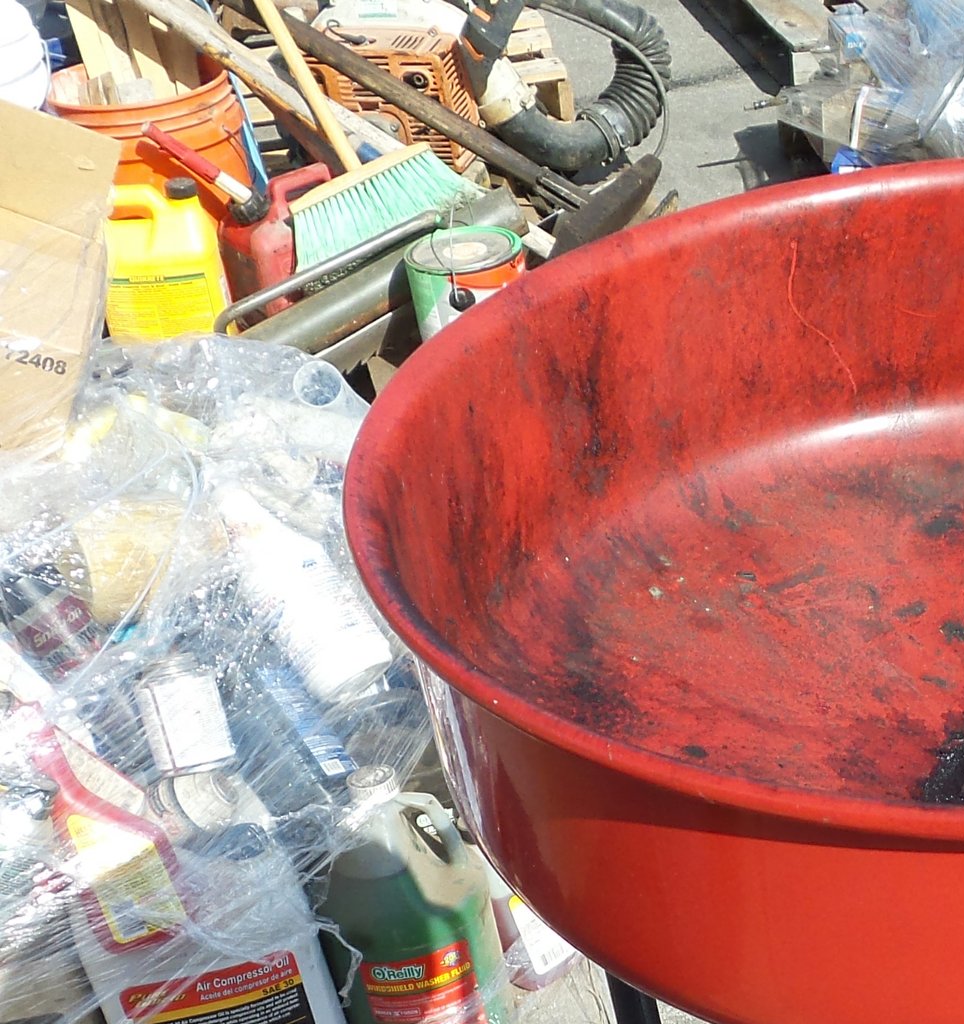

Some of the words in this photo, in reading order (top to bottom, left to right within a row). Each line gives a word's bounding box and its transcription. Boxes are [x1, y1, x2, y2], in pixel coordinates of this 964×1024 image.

[196, 981, 210, 992] Air
[213, 961, 274, 987] Compressor
[276, 954, 290, 968] Oil
[200, 988, 221, 1001] Aceite
[222, 985, 234, 996] del
[234, 976, 270, 994] compresor
[271, 973, 280, 981] de
[280, 968, 293, 978] aire
[367, 983, 414, 992] WINDSHIELD
[416, 973, 450, 989] WASHER
[451, 962, 471, 977] FLUID
[373, 963, 425, 980] O'Reilly
[262, 984, 280, 996] SAE
[283, 978, 295, 988] 30
